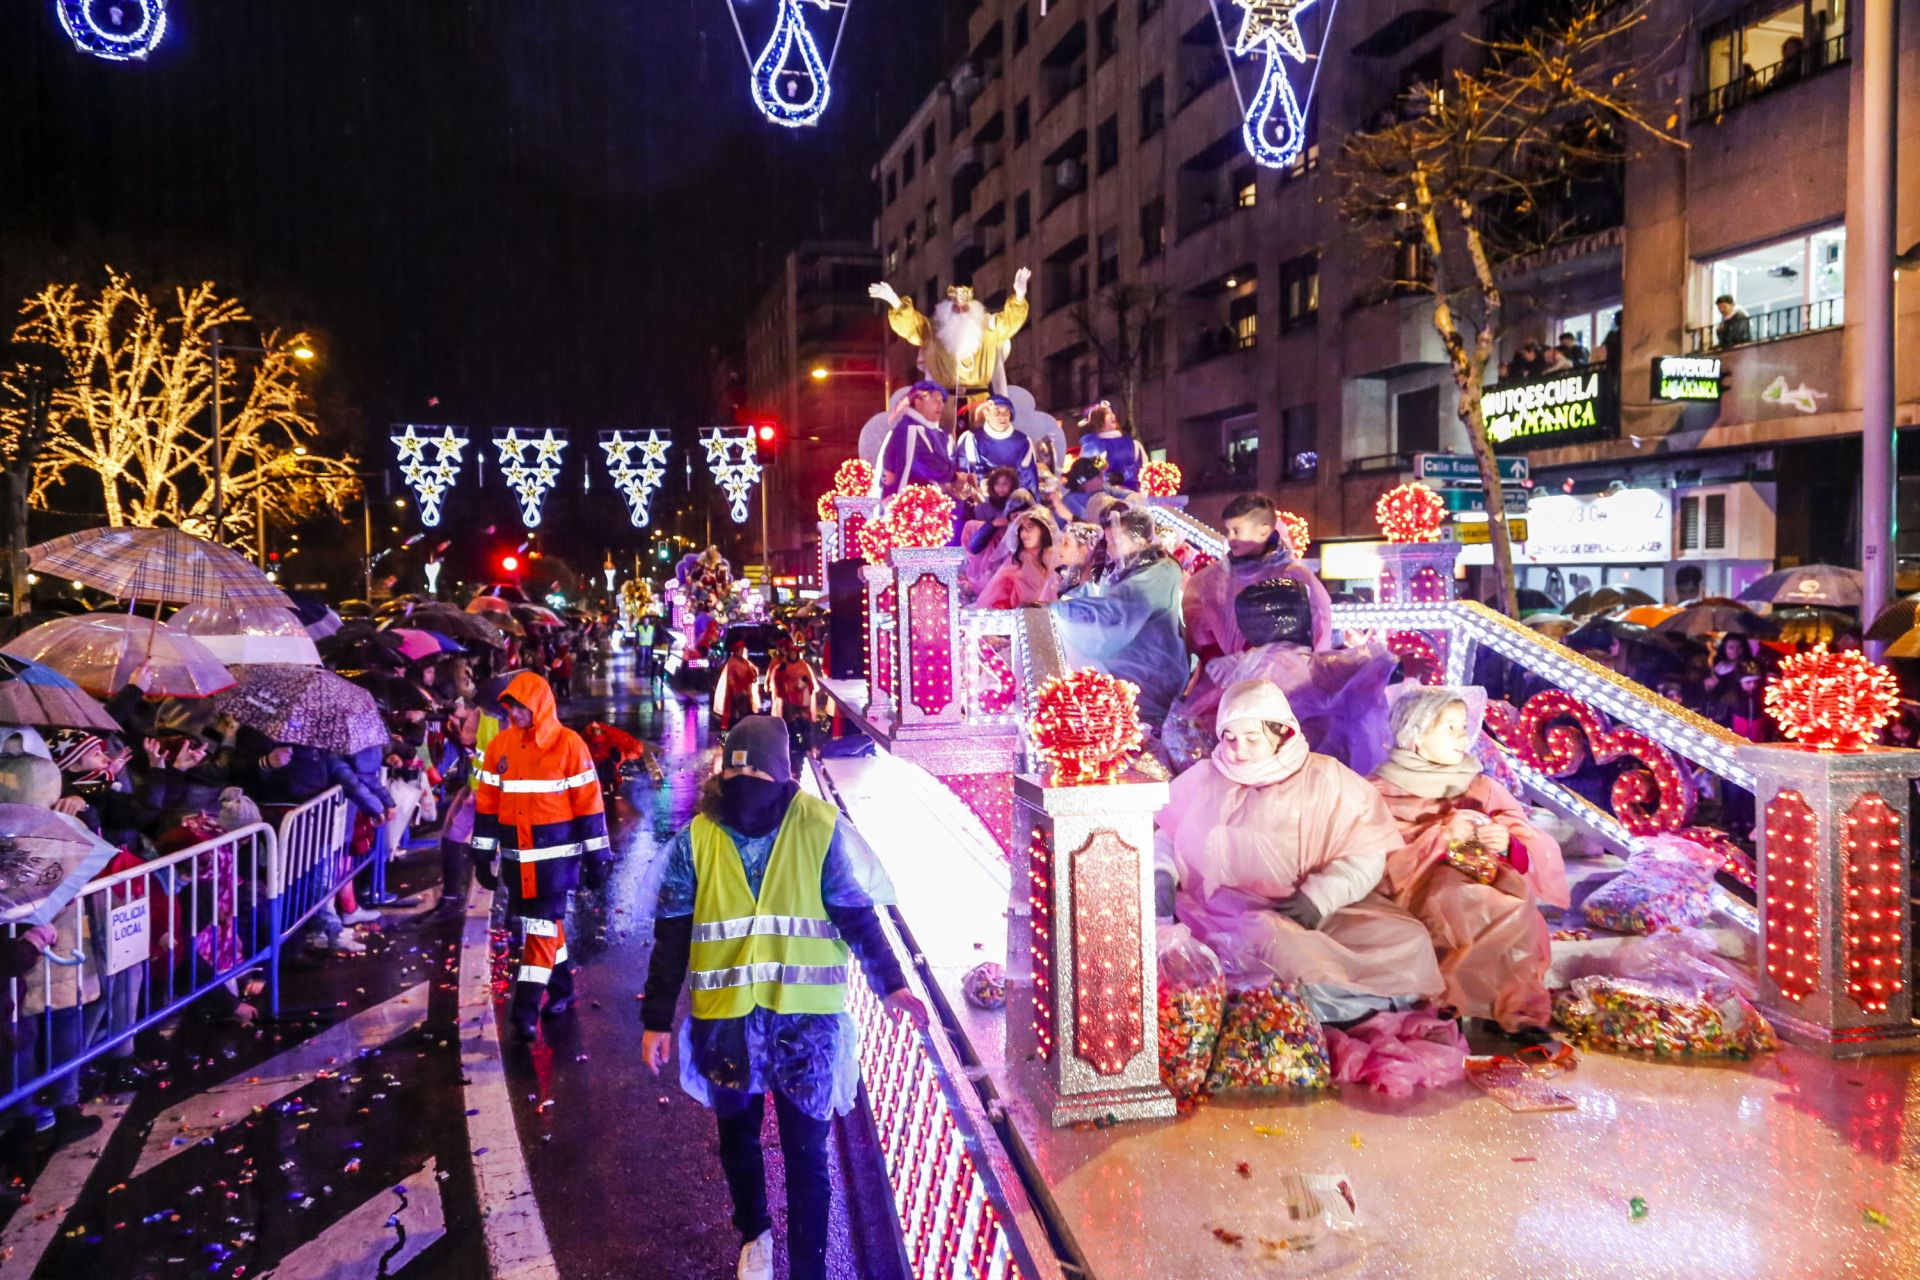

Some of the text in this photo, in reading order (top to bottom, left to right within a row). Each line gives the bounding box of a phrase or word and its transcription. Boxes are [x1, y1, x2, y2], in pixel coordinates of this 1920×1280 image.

[1661, 379, 1719, 399] SAAMANCA
[1482, 401, 1596, 442] AAMANCA
[1425, 460, 1480, 474] Calle Espa
[112, 905, 146, 926] POLICIA
[114, 922, 143, 941] LOCAL
